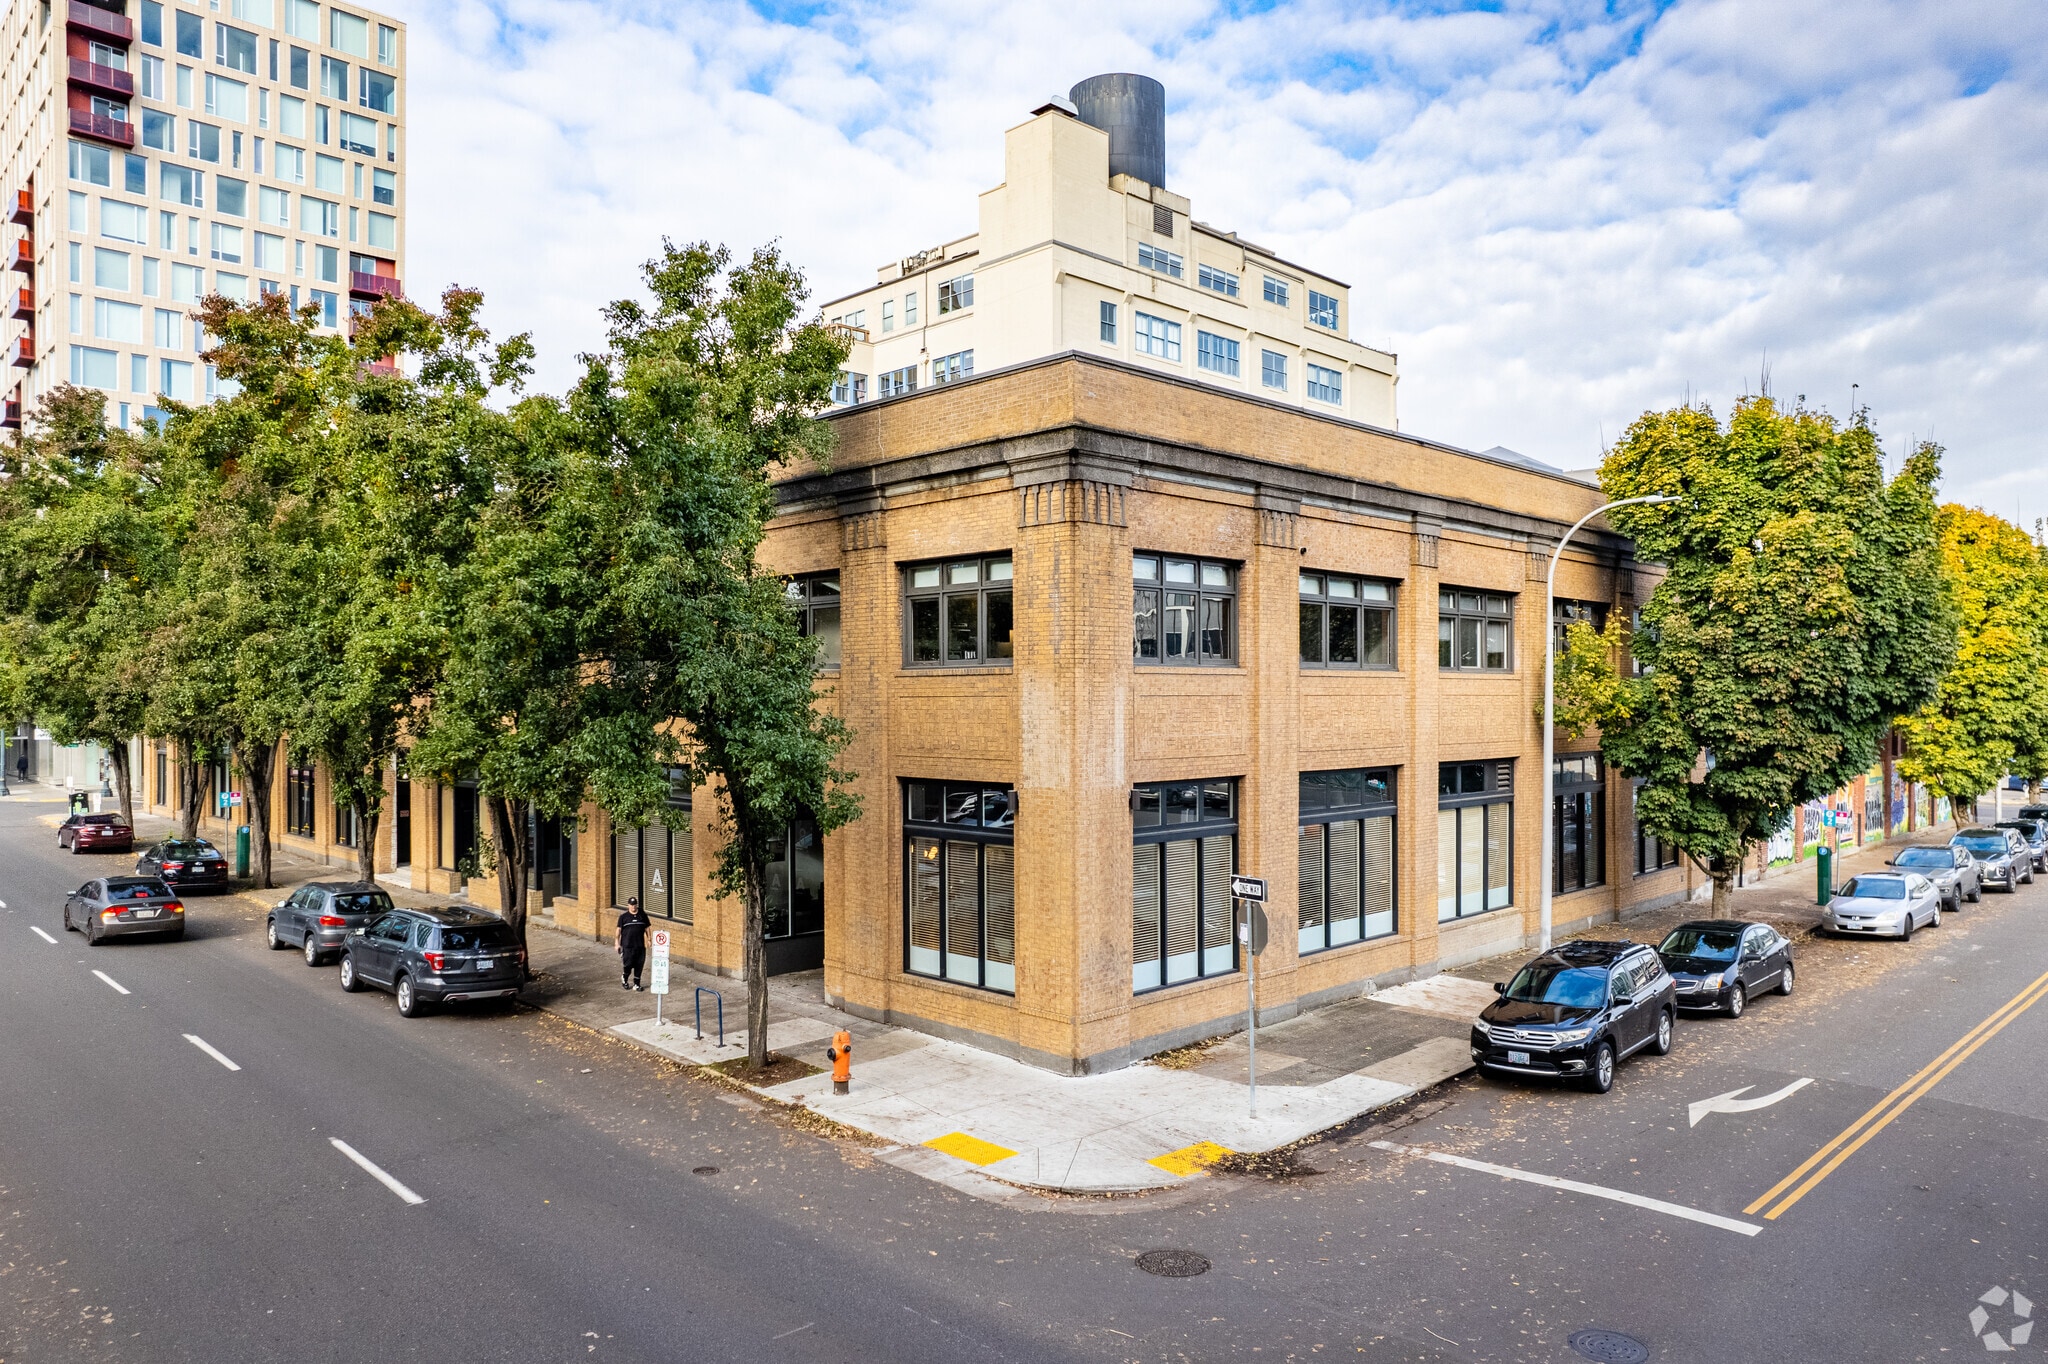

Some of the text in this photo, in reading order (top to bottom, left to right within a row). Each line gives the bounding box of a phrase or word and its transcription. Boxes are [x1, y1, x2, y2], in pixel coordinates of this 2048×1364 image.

[652, 868, 663, 886] A
[1239, 883, 1261, 895] ONE WAY
